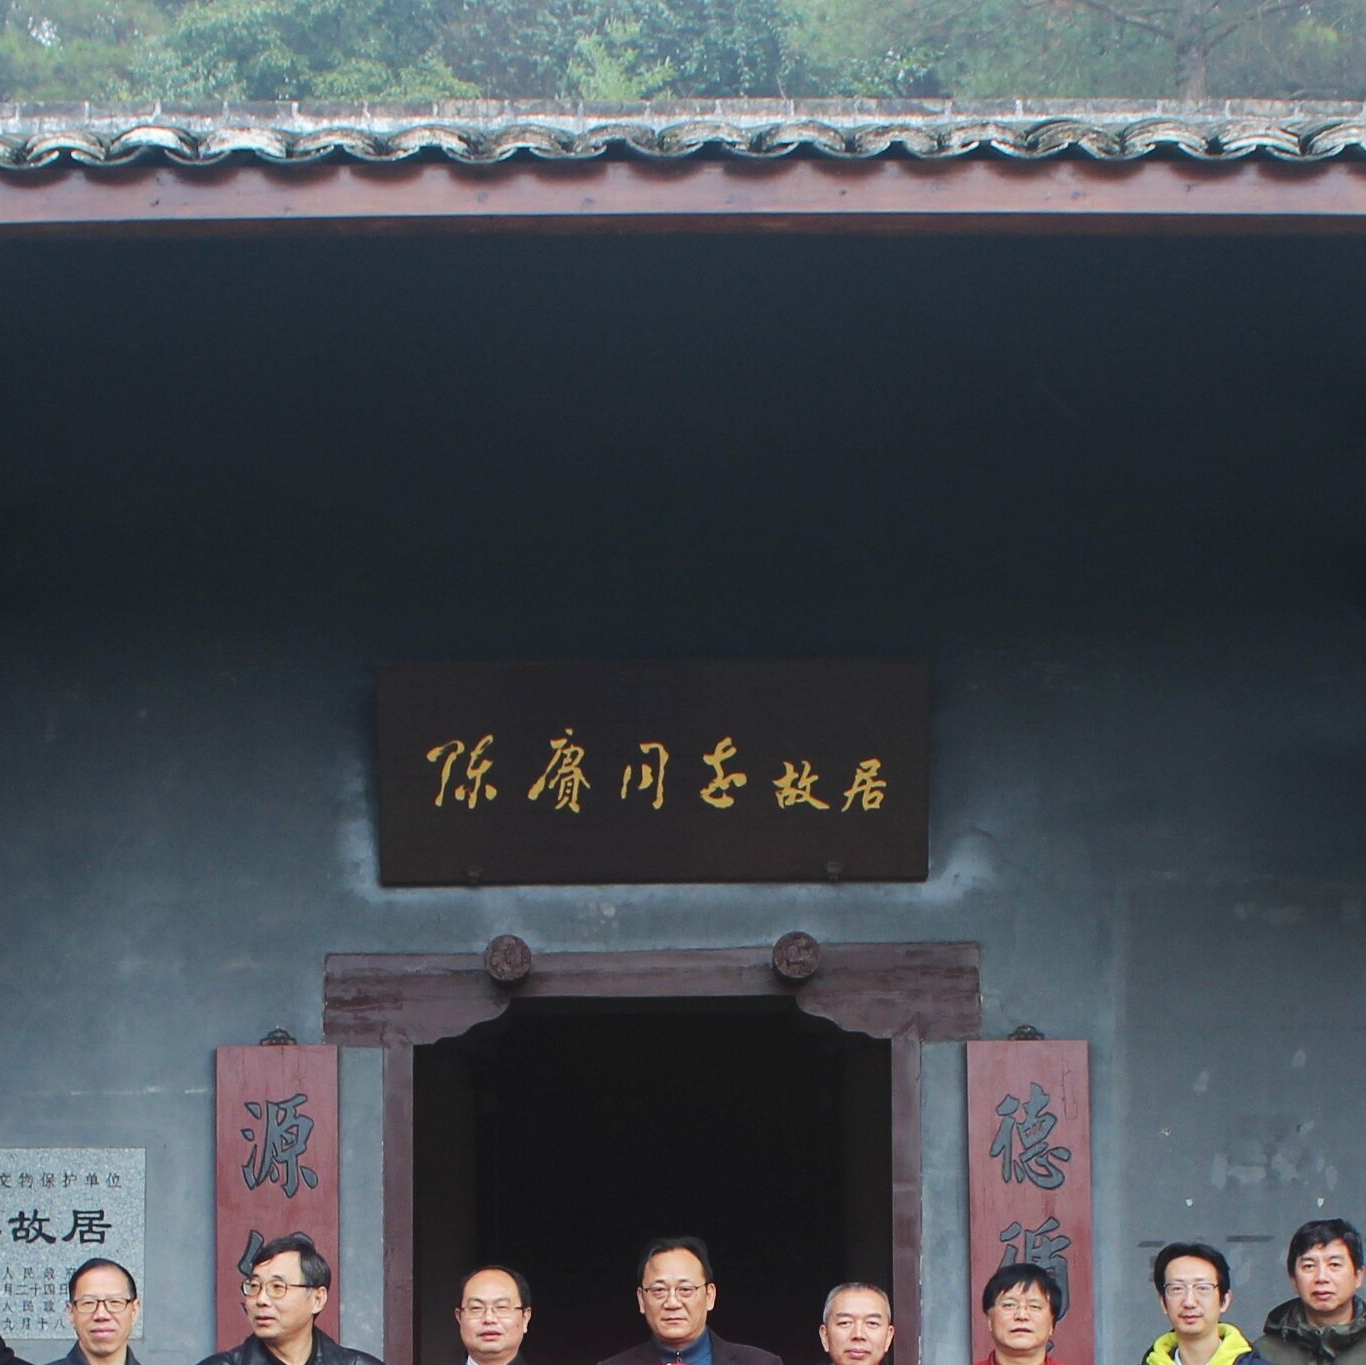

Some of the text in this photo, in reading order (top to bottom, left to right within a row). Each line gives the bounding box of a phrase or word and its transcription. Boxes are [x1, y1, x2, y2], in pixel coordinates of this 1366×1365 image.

[427, 729, 887, 813] 陈赓同志故居
[2, 1301, 67, 1313] 人民政
